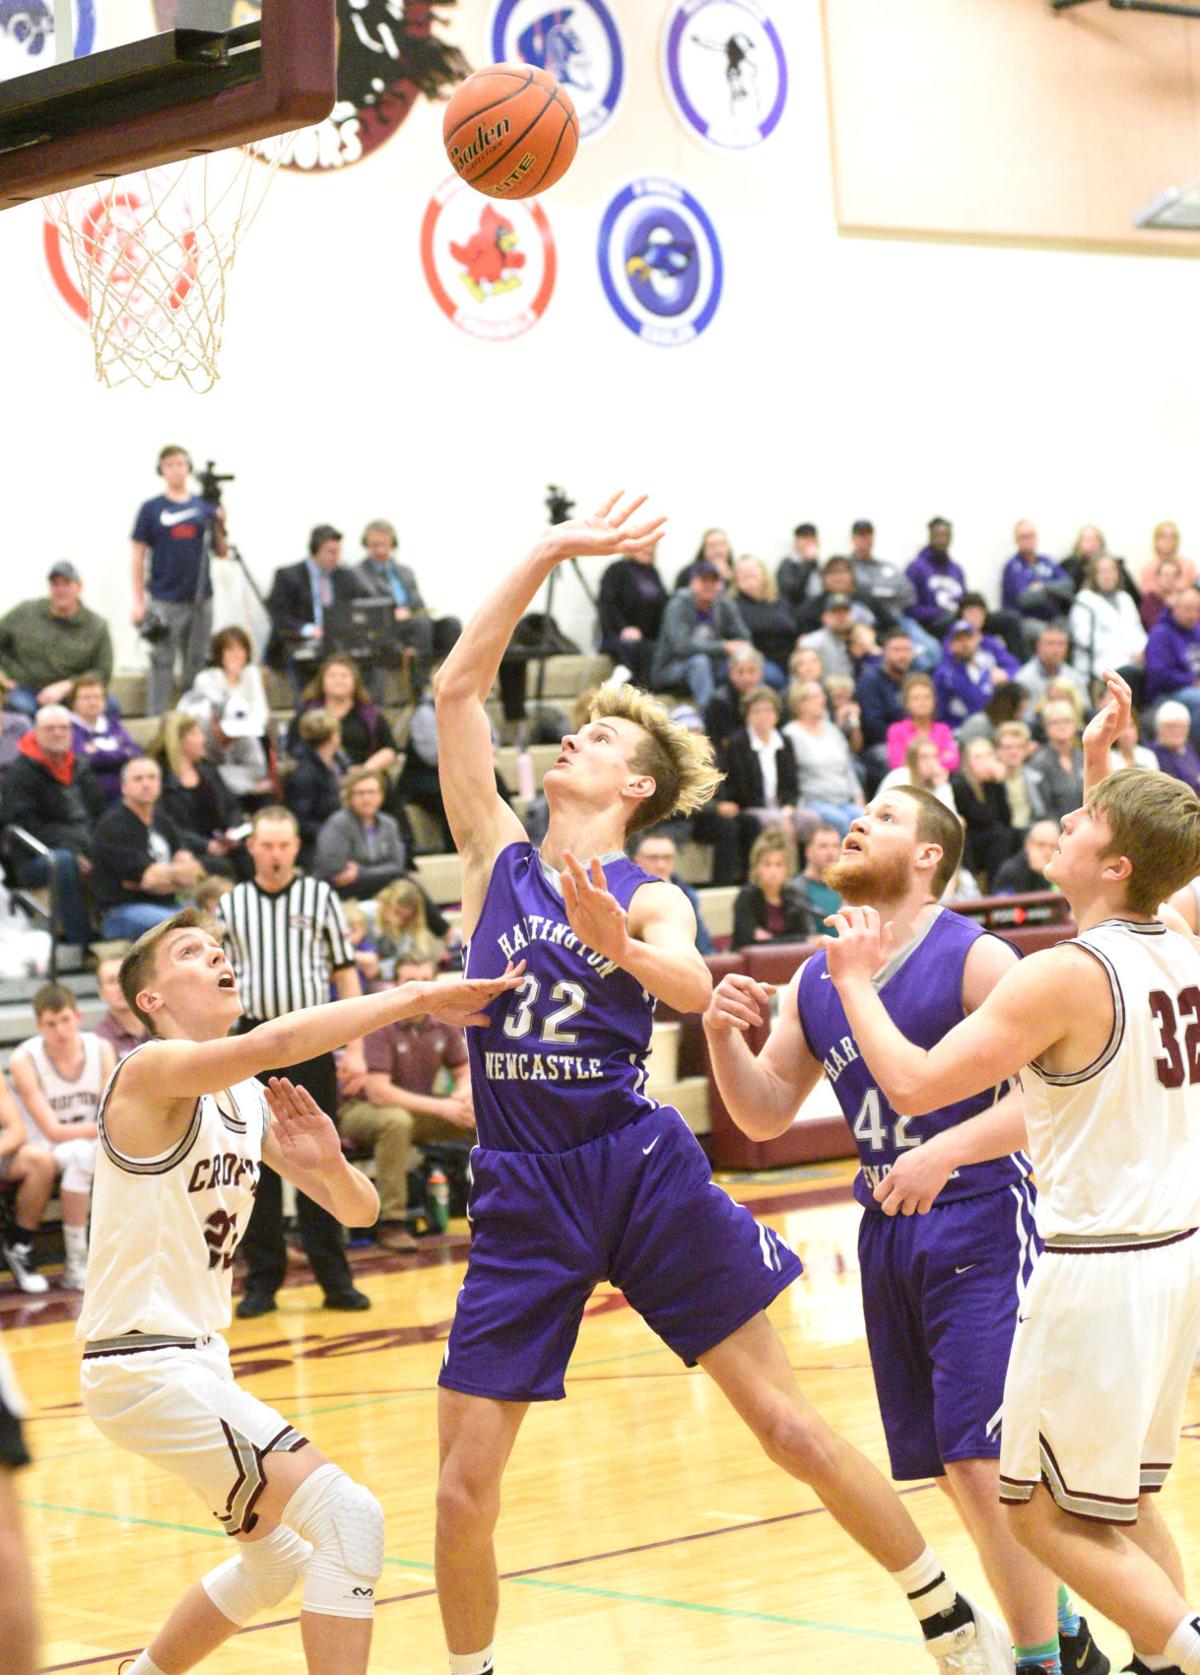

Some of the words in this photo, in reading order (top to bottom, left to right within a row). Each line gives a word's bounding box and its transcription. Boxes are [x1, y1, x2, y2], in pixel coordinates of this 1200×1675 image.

[449, 117, 511, 173] Baden
[502, 972, 588, 1045] 32
[1148, 984, 1200, 1089] 32
[484, 1051, 604, 1081] NEWCASTLE
[853, 1087, 922, 1152] 42
